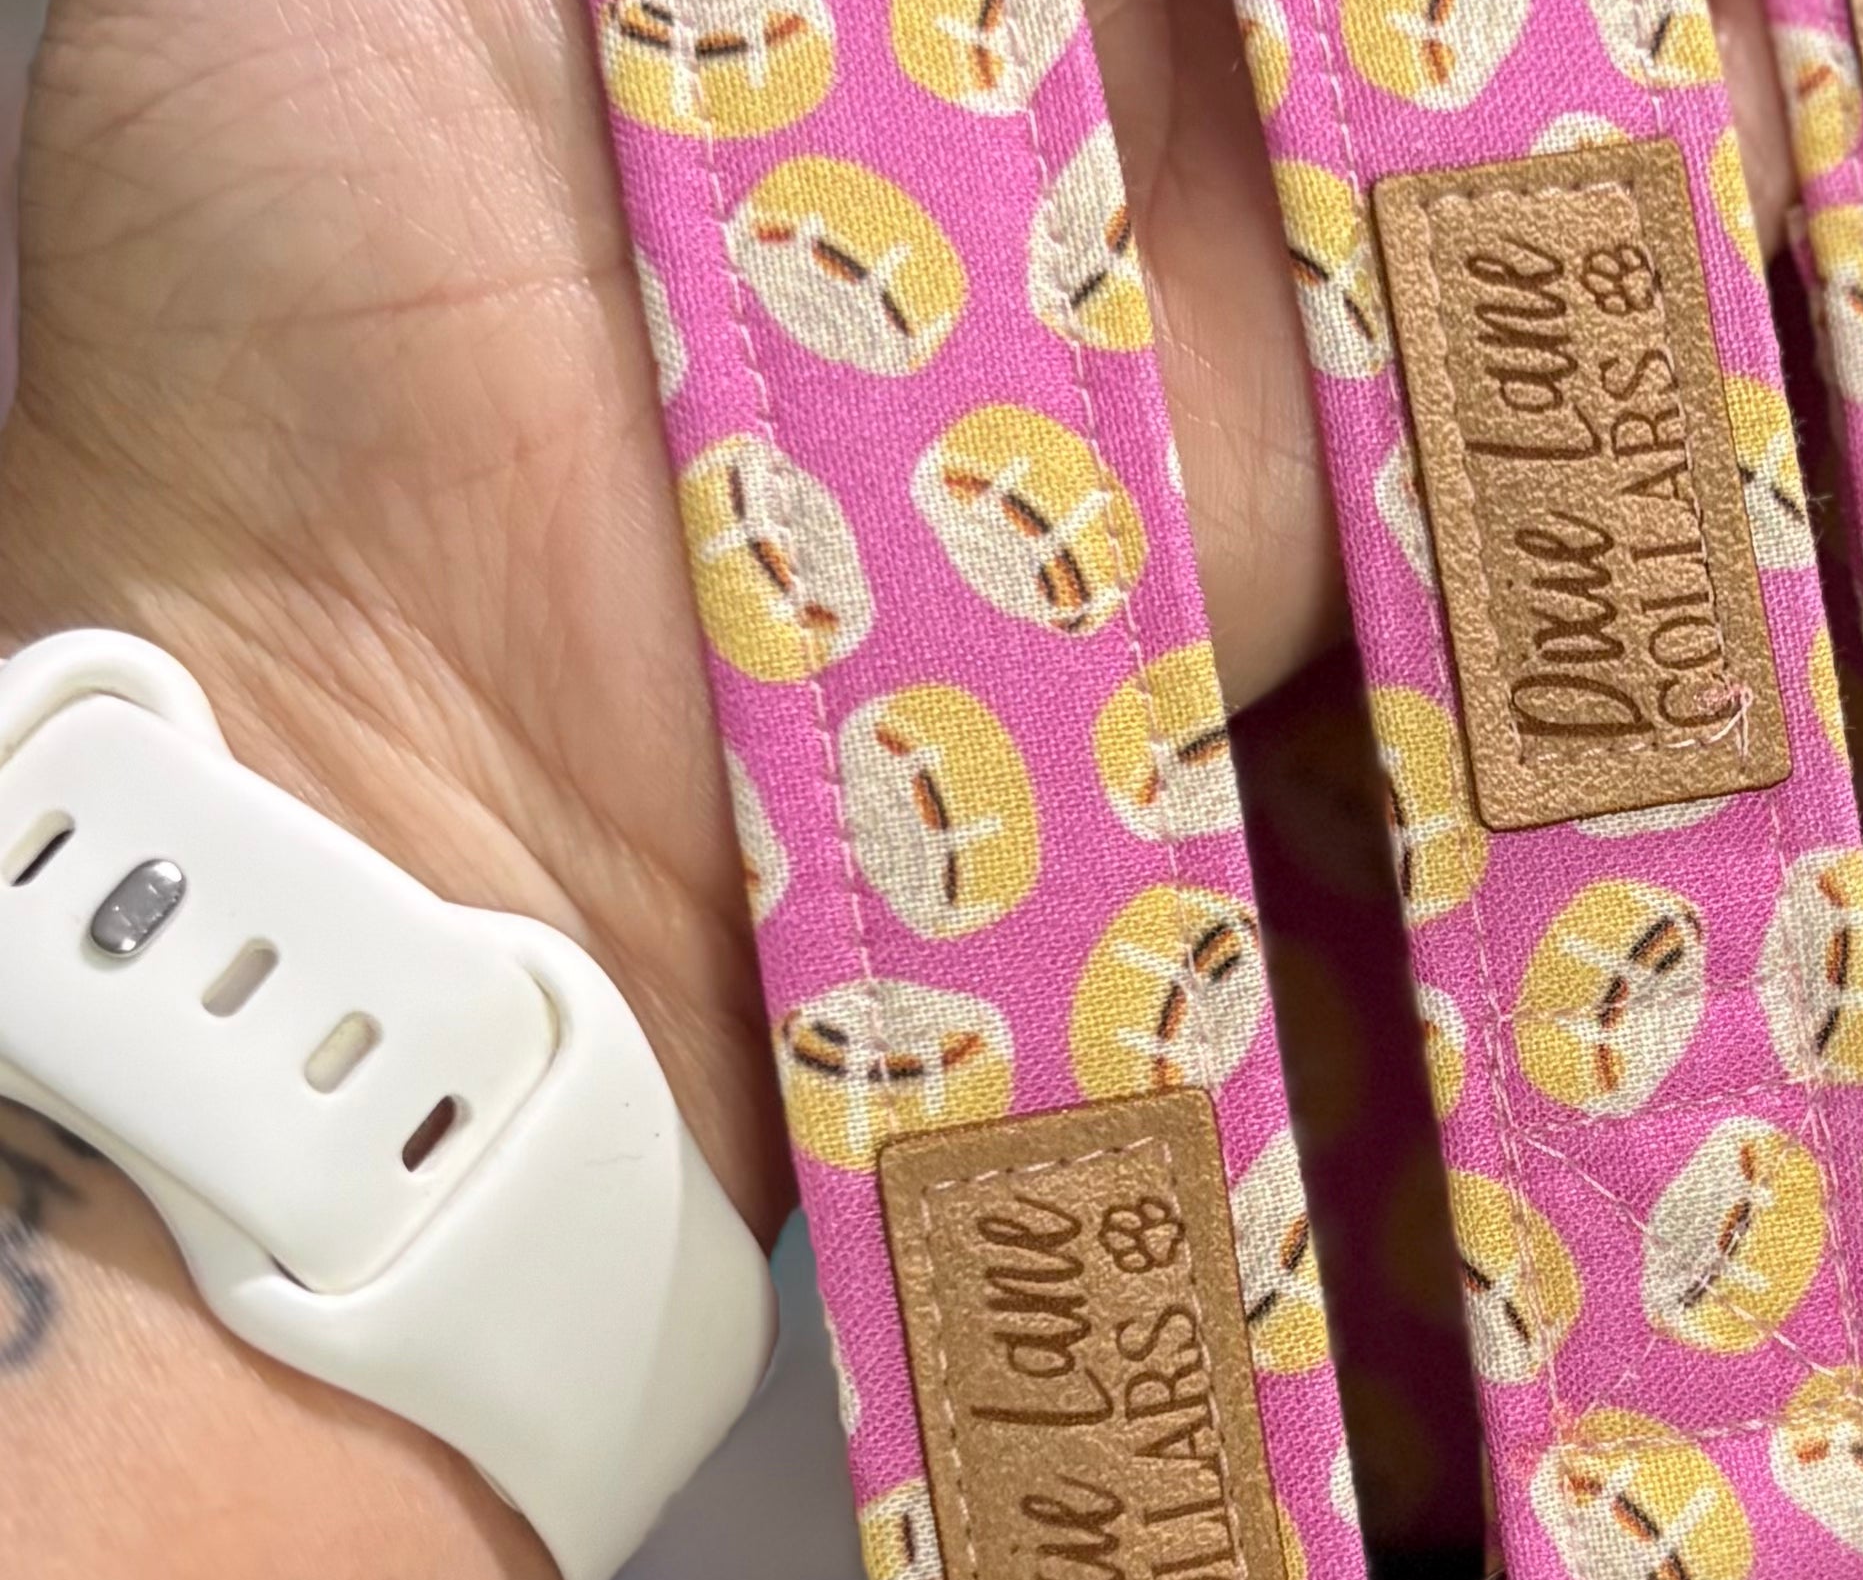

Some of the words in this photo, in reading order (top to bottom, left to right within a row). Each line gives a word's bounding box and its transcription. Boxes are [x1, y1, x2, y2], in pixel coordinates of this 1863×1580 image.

[1466, 239, 1602, 460] Lane
[1509, 514, 1654, 736] Dixie
[1601, 349, 1740, 728] COLLARS
[971, 1197, 1115, 1427] Lane
